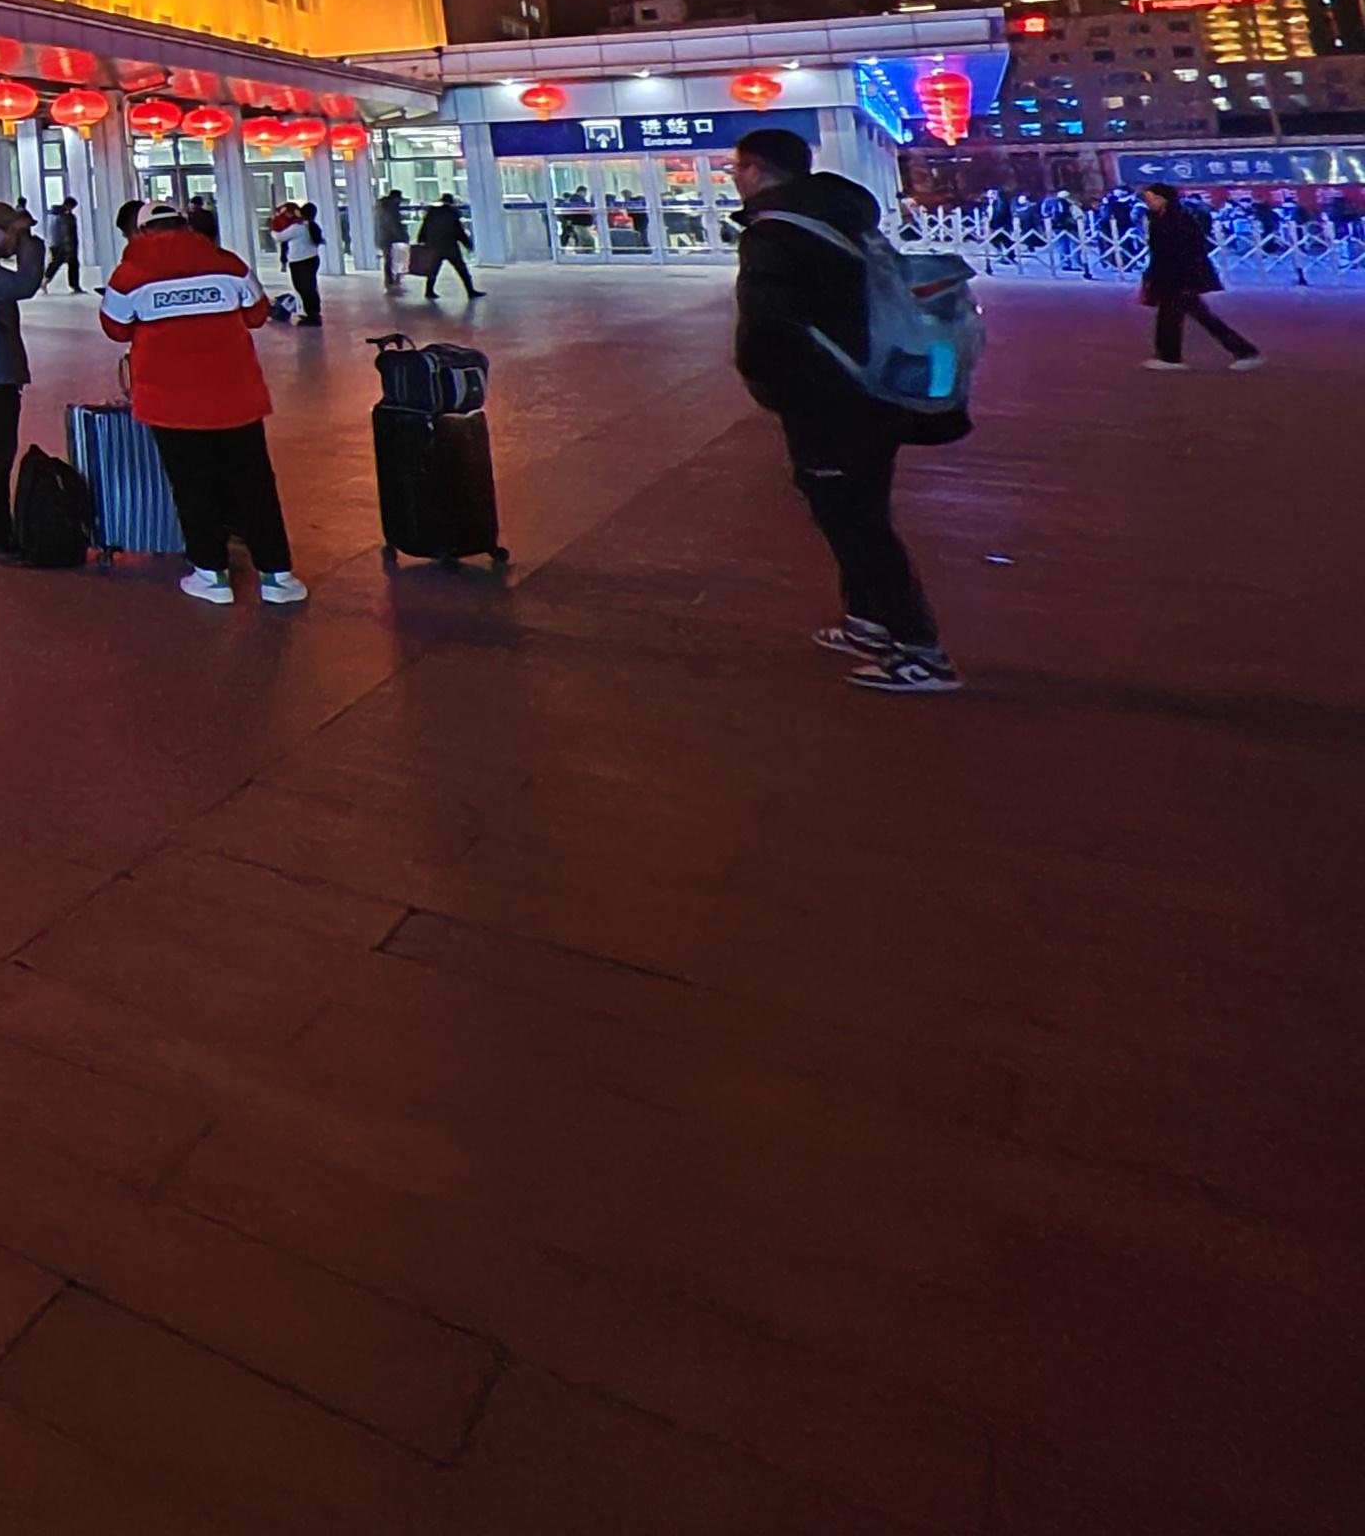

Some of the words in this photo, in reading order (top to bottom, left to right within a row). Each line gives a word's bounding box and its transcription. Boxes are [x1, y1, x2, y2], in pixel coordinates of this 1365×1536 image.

[639, 117, 714, 136] 进站口
[154, 287, 221, 308] RACING
